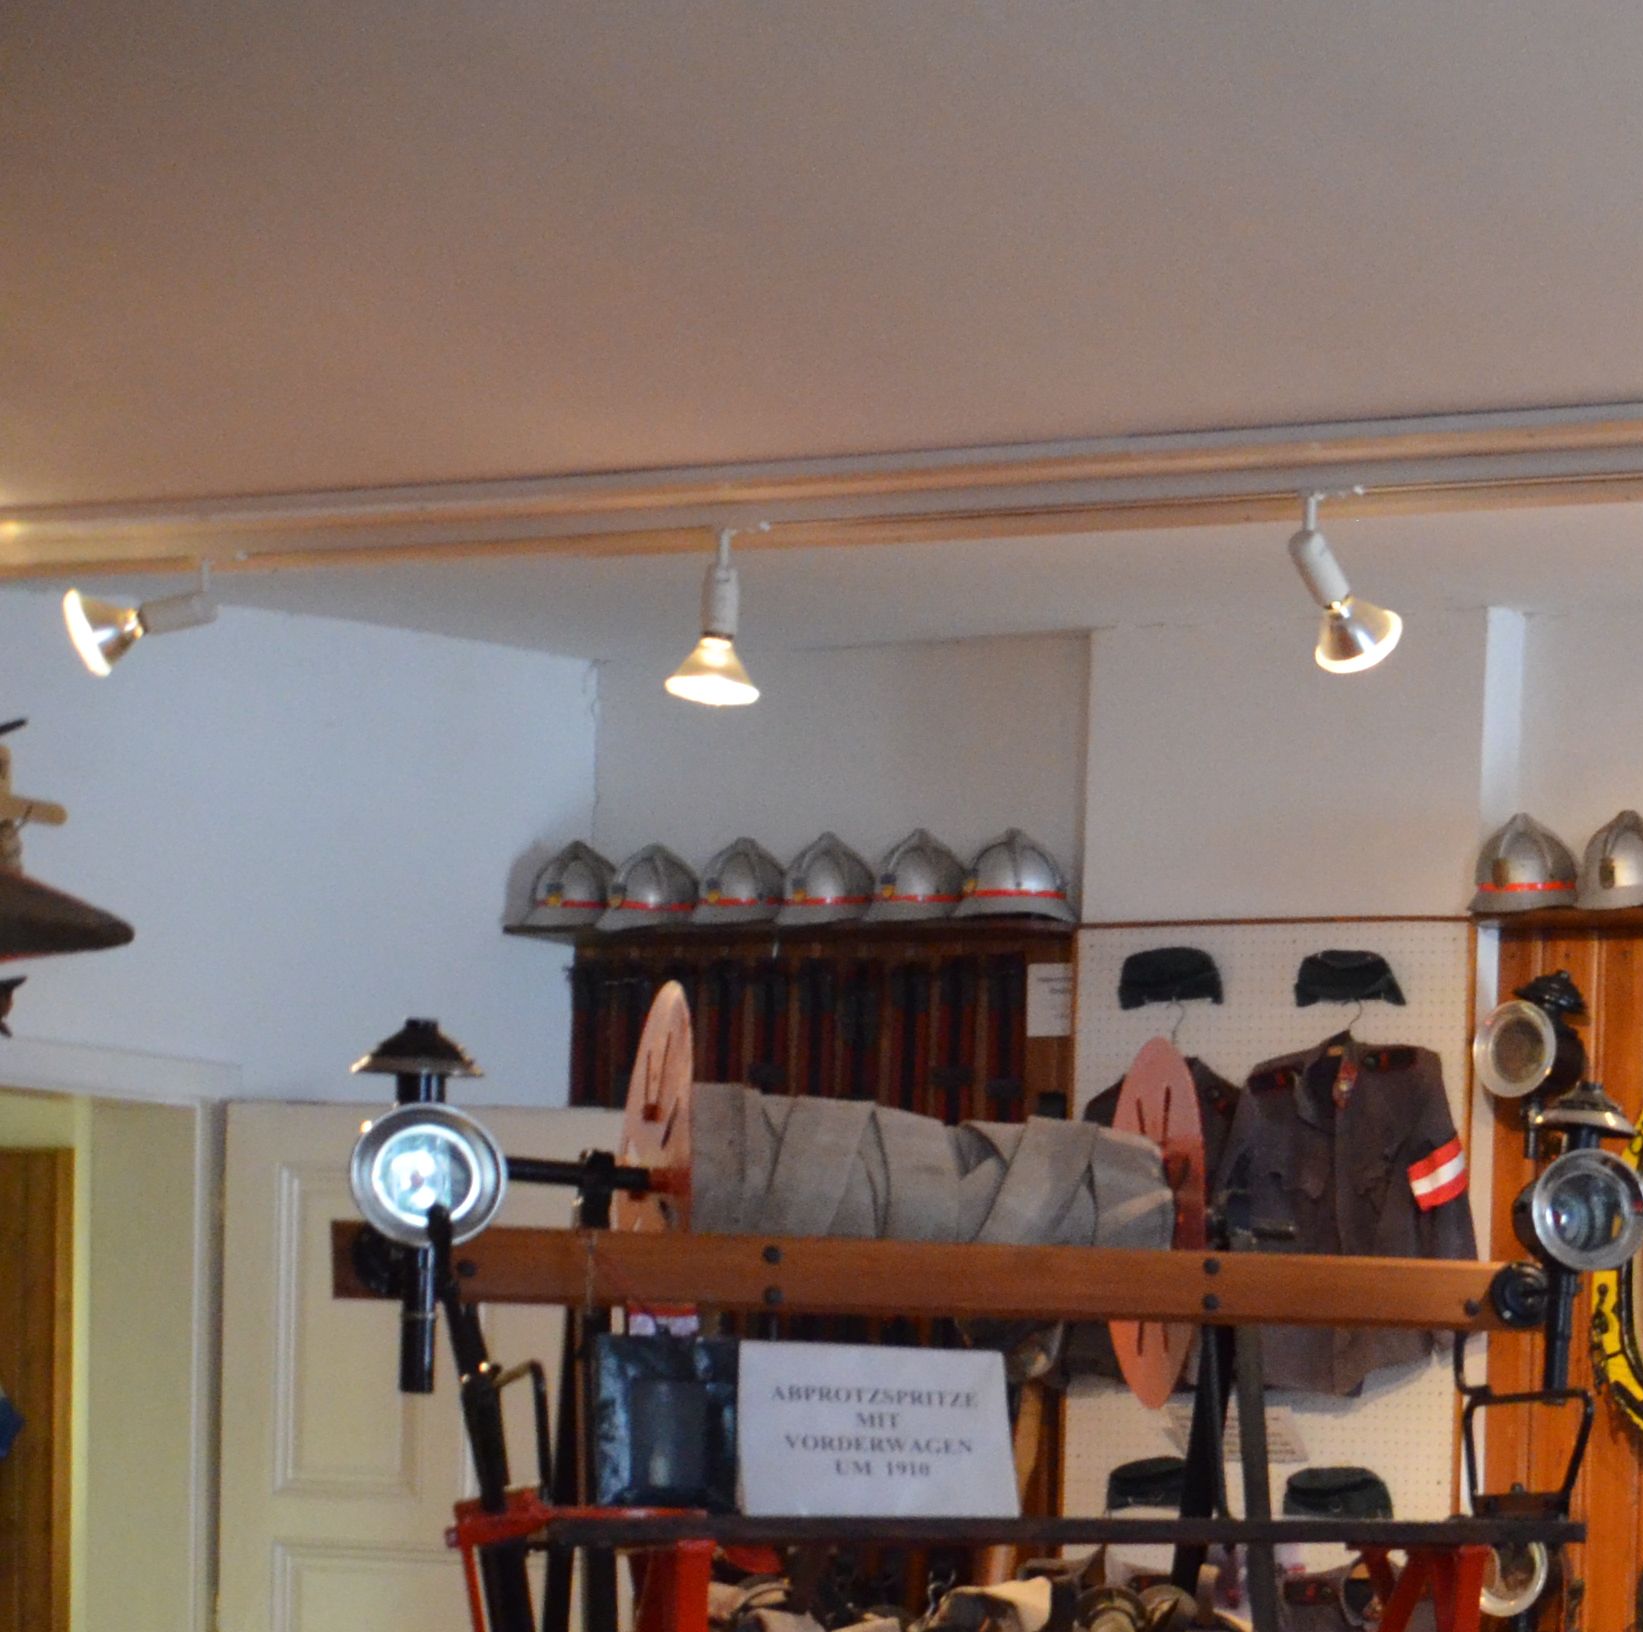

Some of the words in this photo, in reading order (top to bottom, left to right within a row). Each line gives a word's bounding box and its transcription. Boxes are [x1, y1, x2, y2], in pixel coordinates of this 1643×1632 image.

[771, 1384, 979, 1409] ABPROTZSPRITZE
[855, 1411, 899, 1430] MIT
[783, 1433, 973, 1455] VORDERWAGEN
[833, 1459, 873, 1477] UM
[885, 1460, 931, 1478] 1910
